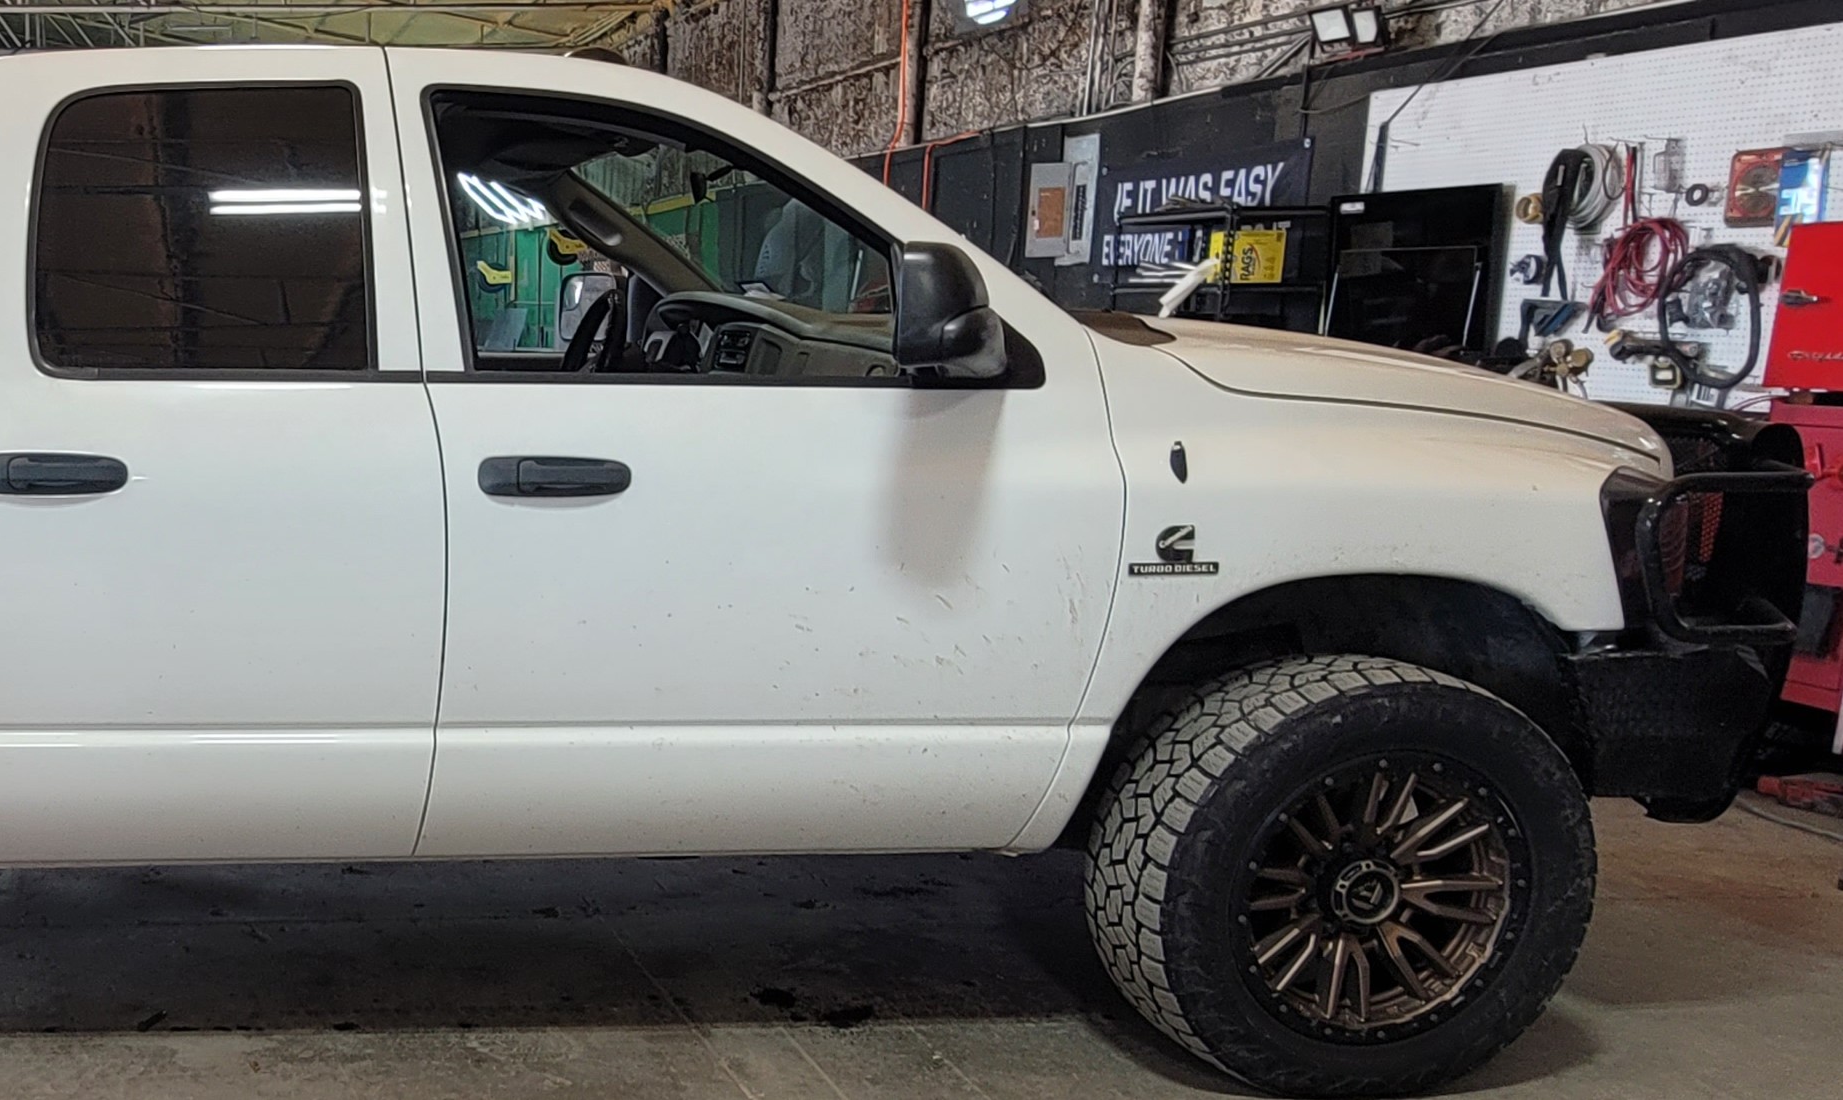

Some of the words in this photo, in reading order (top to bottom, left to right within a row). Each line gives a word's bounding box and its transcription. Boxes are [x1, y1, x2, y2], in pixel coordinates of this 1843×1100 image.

[1113, 181, 1134, 225] IF
[1137, 179, 1157, 214] IT
[1161, 172, 1213, 206] WAS
[1218, 161, 1285, 207] EASY
[1239, 247, 1254, 281] RAGS
[1132, 564, 1173, 574] TURBO
[1174, 563, 1216, 573] DIESEL
